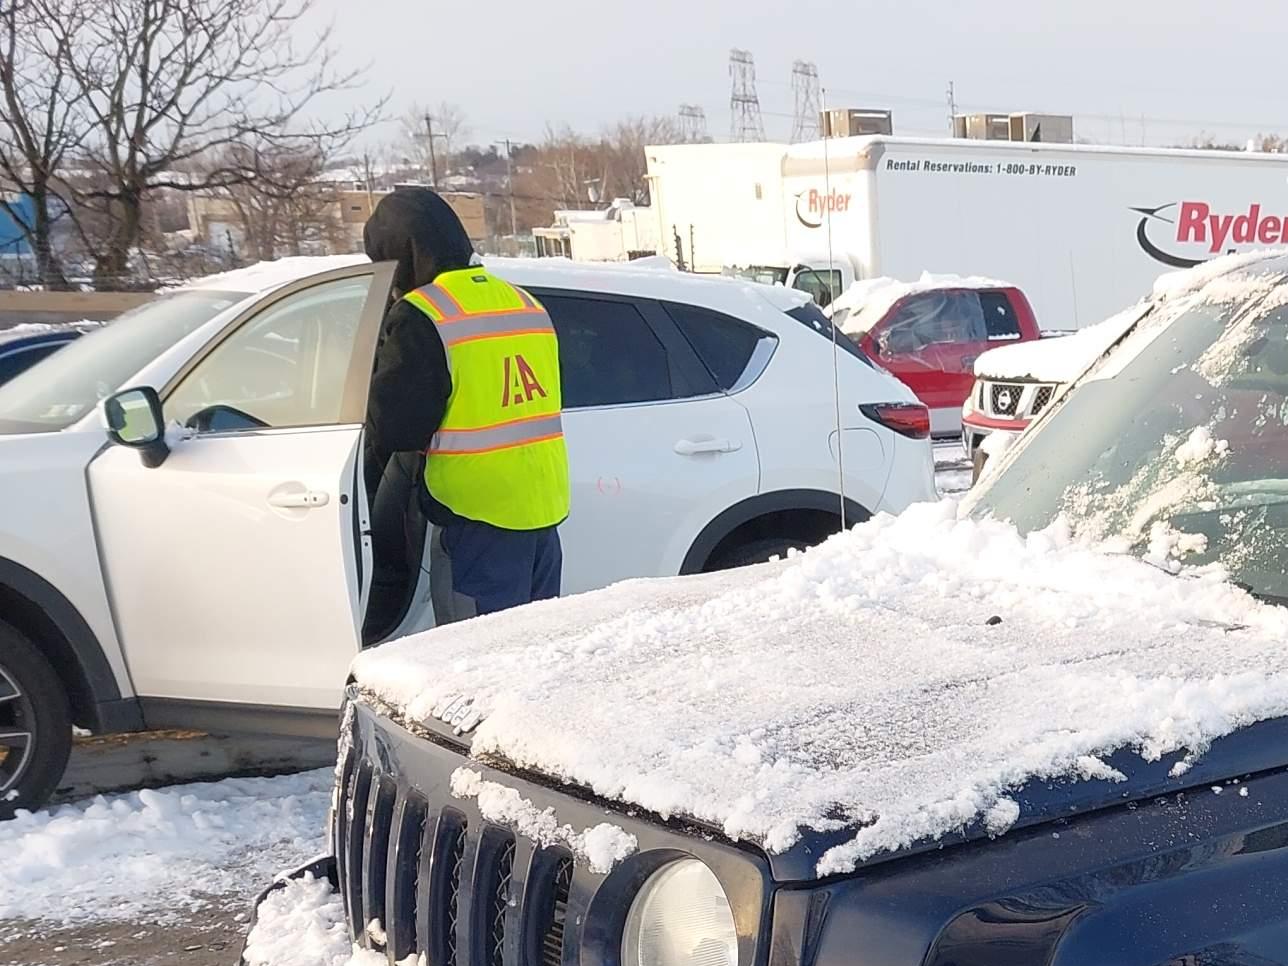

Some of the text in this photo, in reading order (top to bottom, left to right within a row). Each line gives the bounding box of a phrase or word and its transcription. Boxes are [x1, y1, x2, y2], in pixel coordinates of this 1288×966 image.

[886, 159, 1077, 177] Rental Reservations: 1-800-BY-RYDER
[808, 187, 852, 218] Ryder
